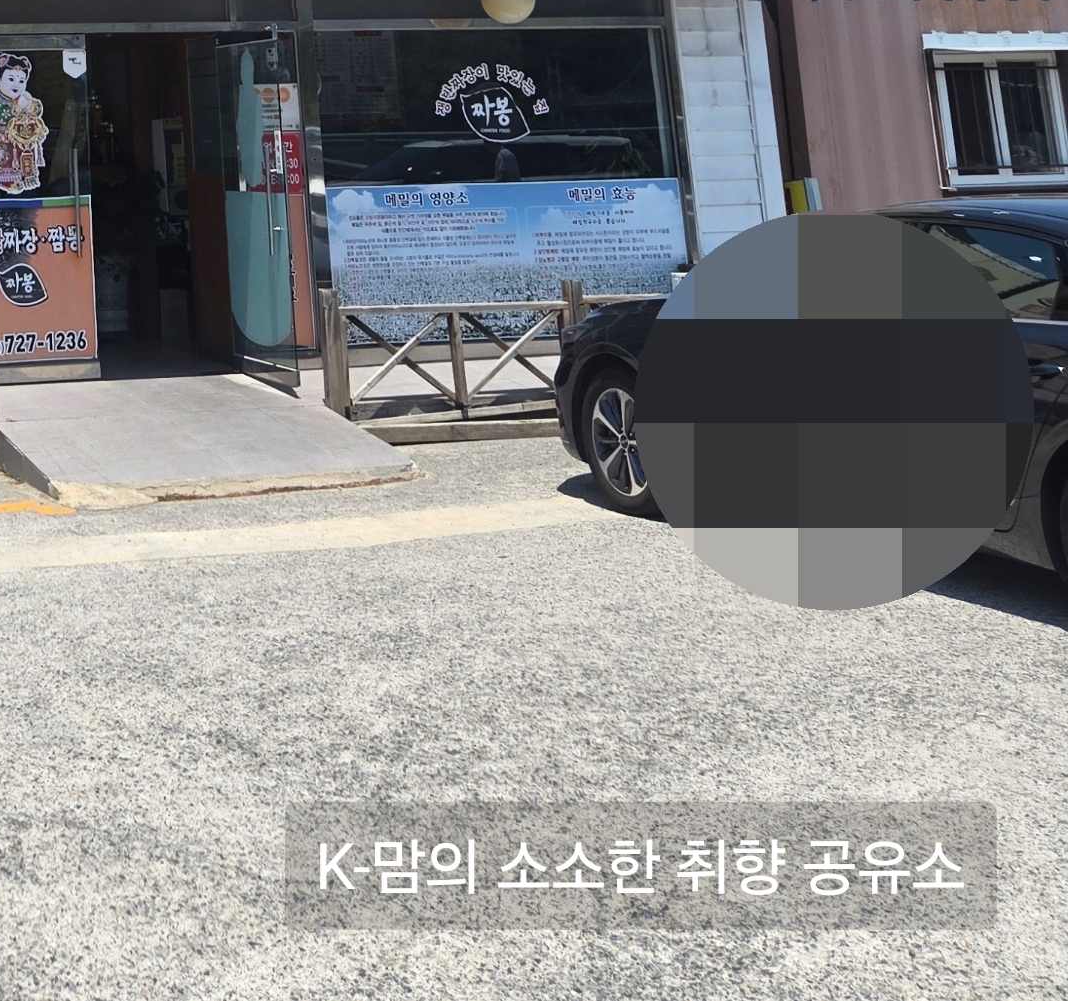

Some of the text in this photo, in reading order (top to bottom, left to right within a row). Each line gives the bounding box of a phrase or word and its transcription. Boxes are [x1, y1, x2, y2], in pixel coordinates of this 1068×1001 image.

[435, 62, 489, 117] 쟁반짜장이
[496, 63, 536, 97] 맛있는
[471, 95, 513, 126] 짜봉
[385, 191, 470, 208] 메밀의 영양소
[567, 186, 637, 203] 메밀의 효능
[5, 272, 36, 294] 짜봉
